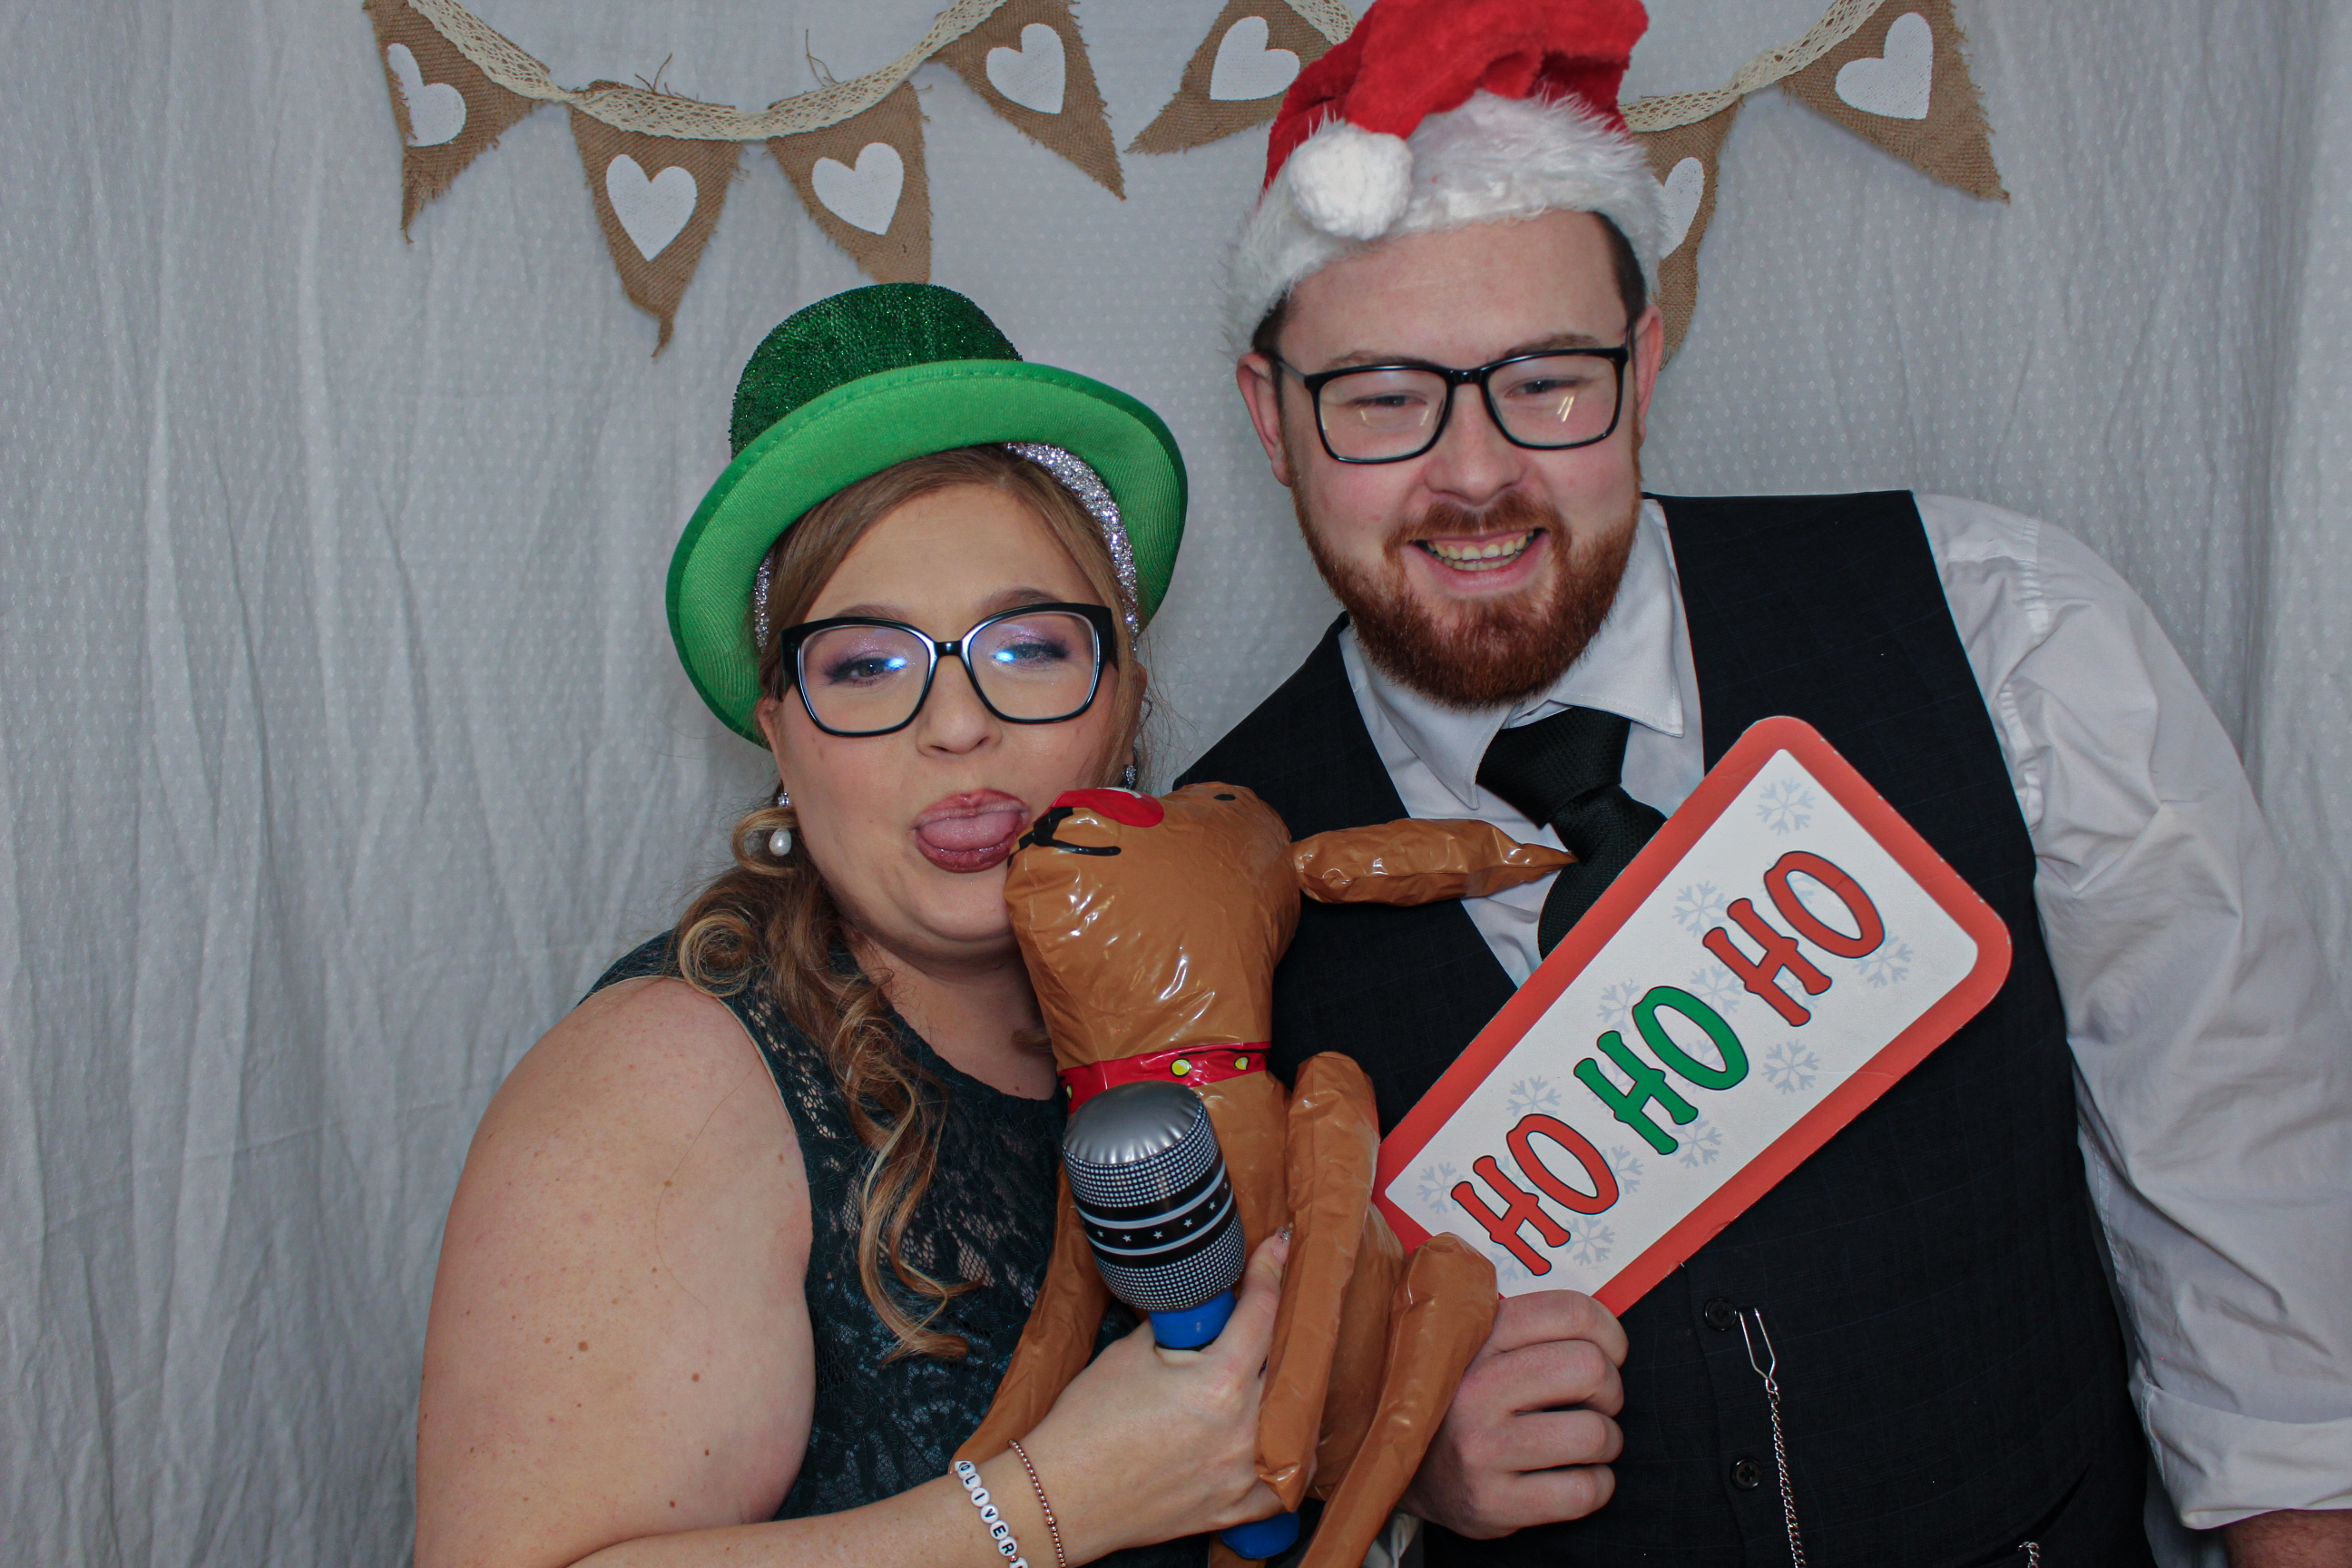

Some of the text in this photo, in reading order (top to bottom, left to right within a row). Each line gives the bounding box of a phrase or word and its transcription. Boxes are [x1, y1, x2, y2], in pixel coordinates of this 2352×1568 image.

[1451, 850, 1886, 1277] HO HO HO
[958, 1462, 1015, 1555] OLIVER
